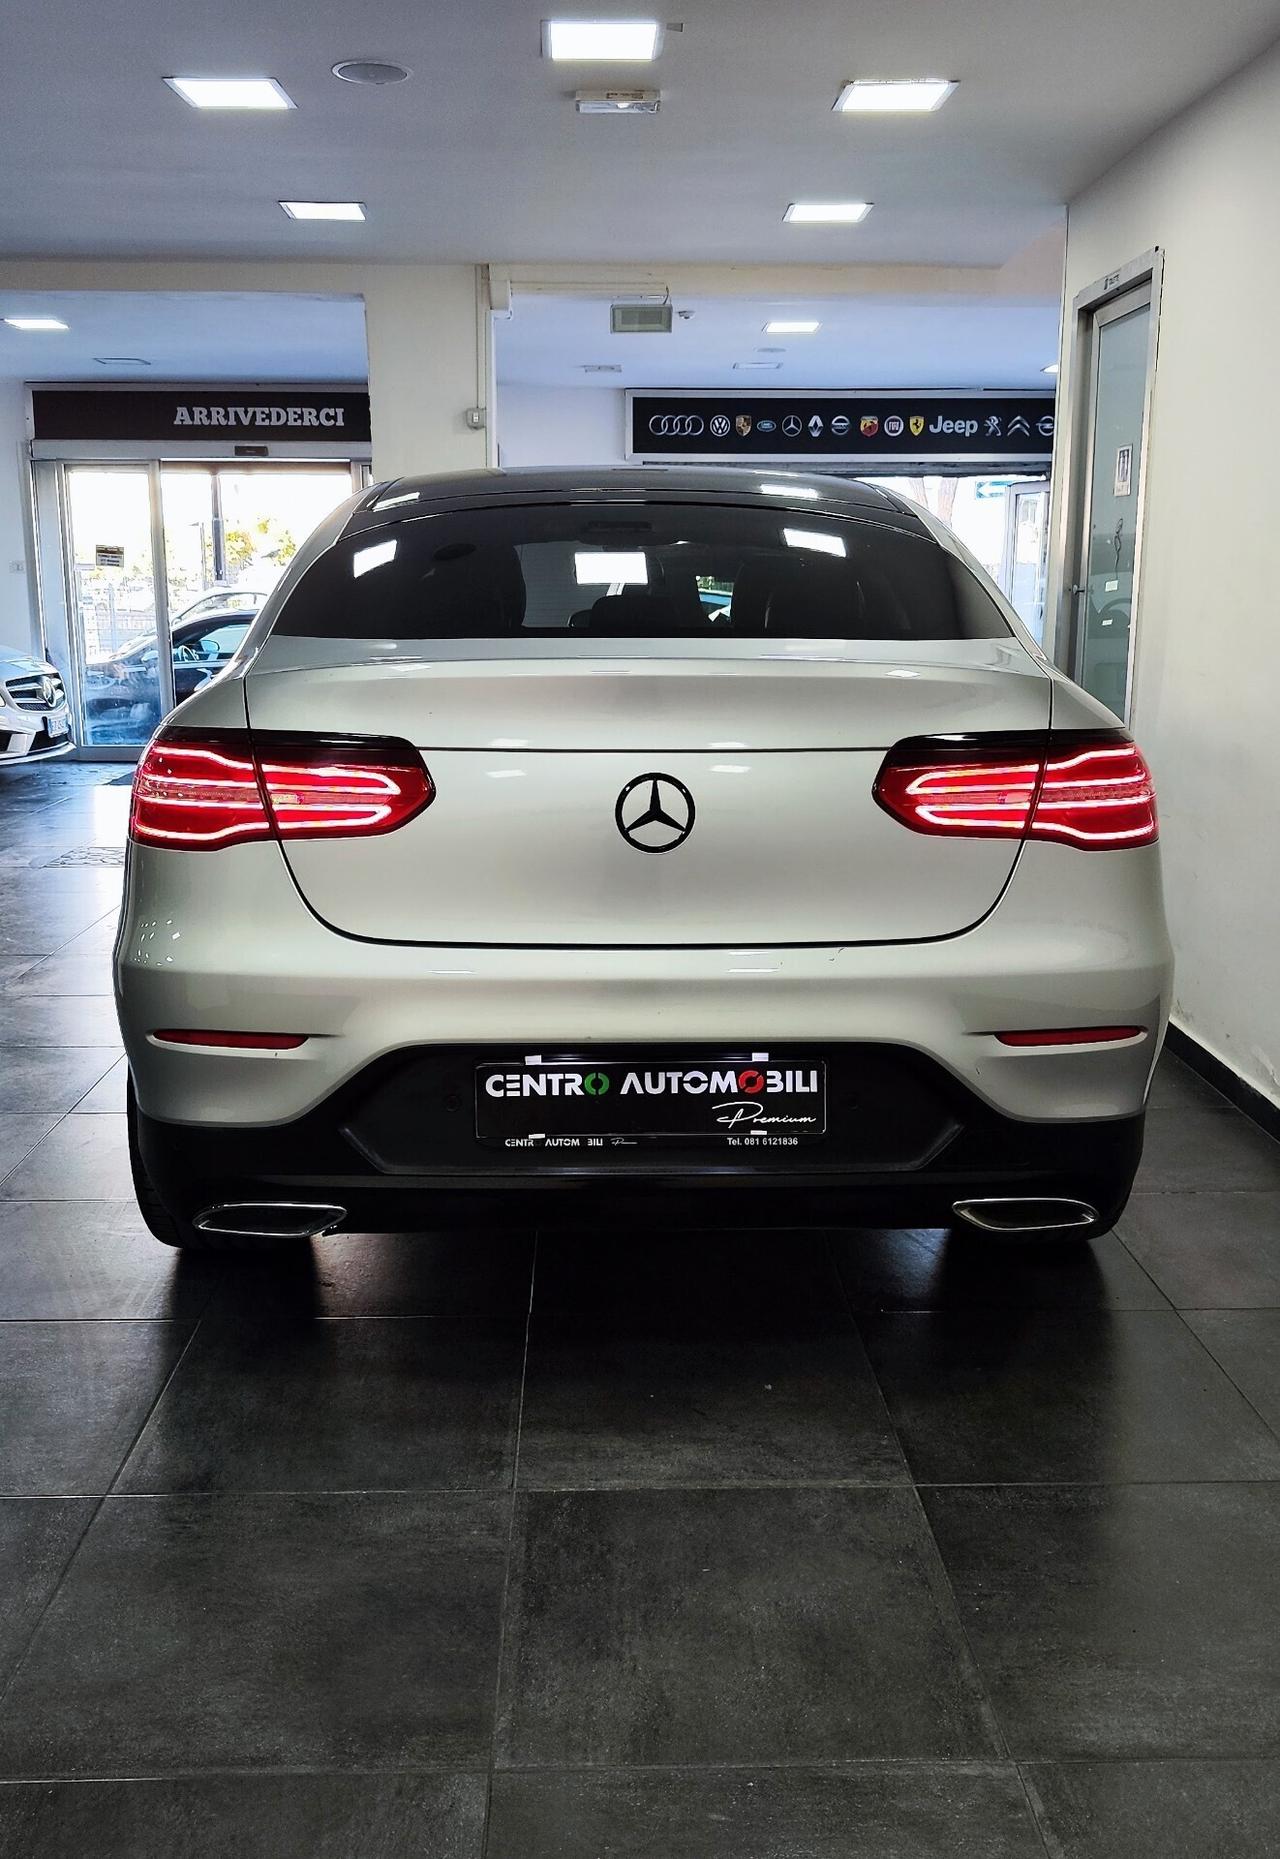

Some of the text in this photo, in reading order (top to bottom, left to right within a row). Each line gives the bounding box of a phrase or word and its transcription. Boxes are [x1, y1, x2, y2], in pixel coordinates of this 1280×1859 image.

[173, 406, 345, 427] ARRIVEDERCI
[928, 415, 979, 437] Jeep
[485, 1069, 818, 1097] CENTRO AUTOMOBILI
[711, 1101, 817, 1129] Premium
[726, 1137, 799, 1146] Tel. 081 6121836
